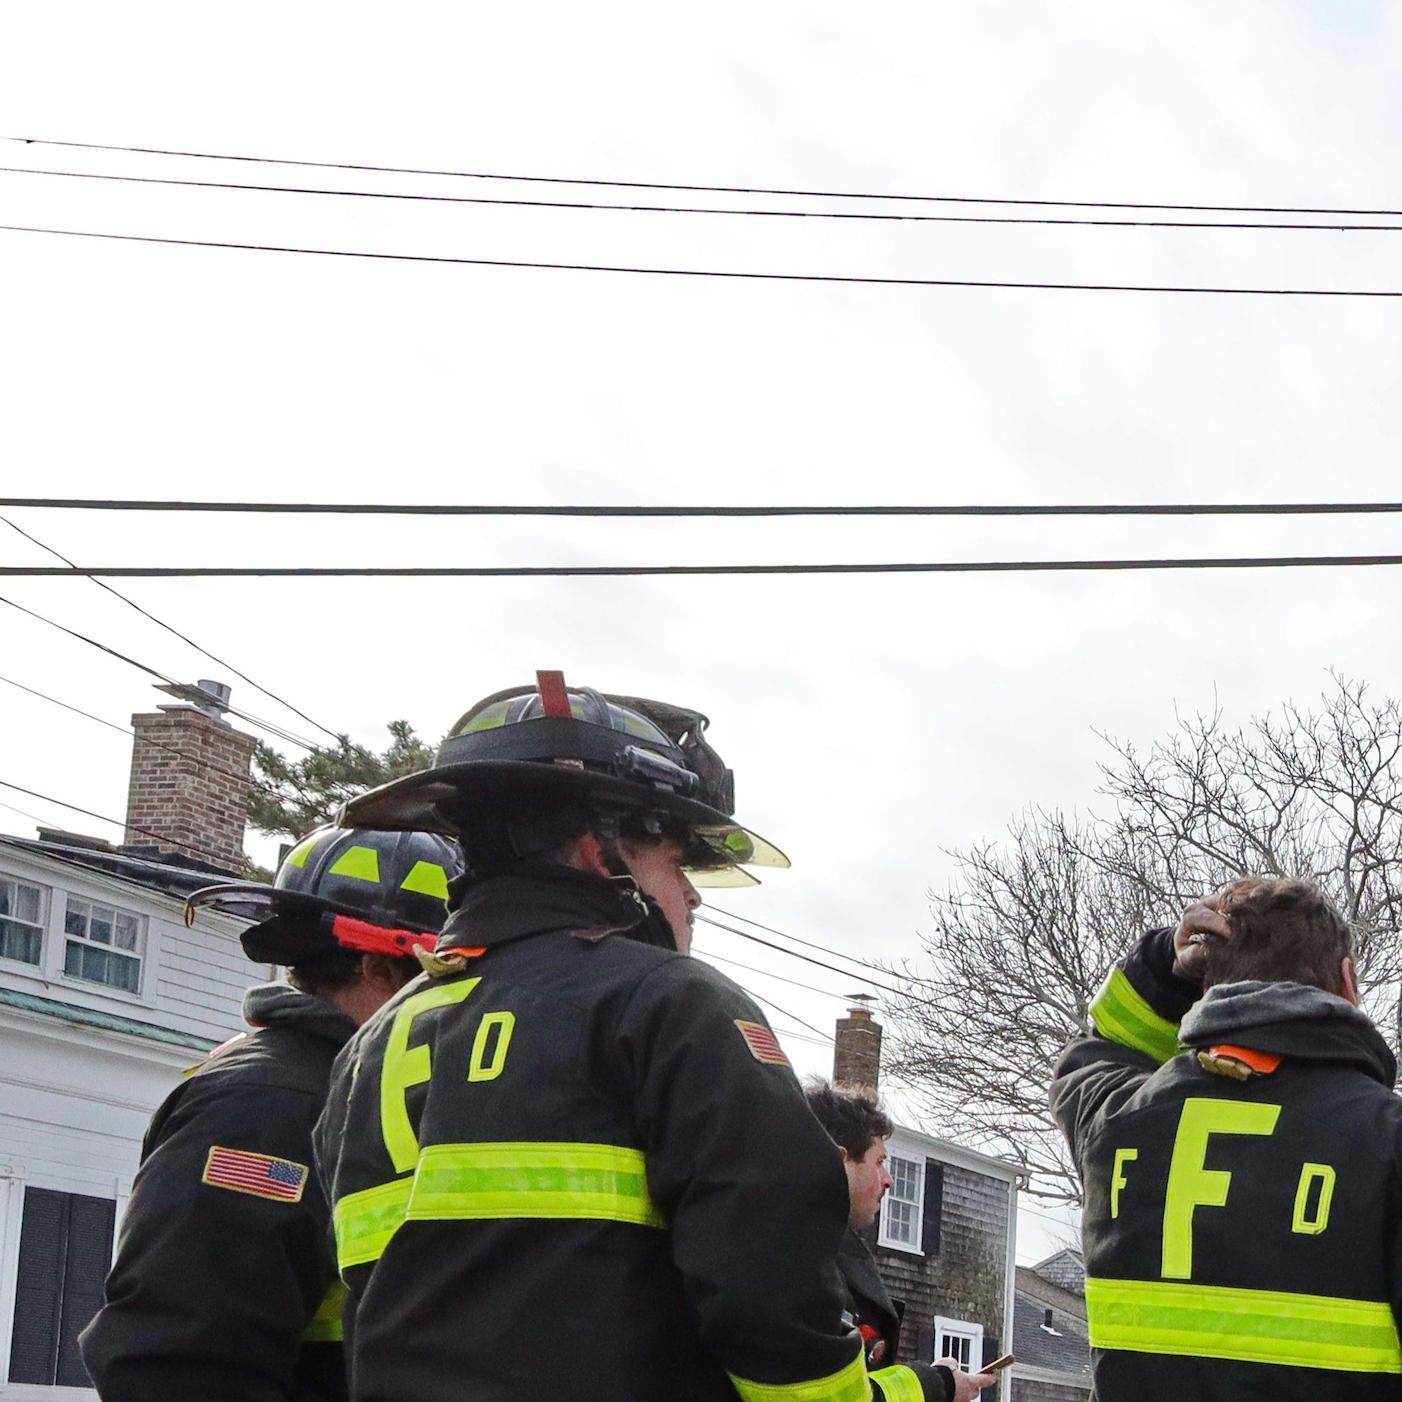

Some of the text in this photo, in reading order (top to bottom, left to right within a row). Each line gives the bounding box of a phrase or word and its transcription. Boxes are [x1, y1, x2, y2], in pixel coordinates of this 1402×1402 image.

[381, 976, 516, 1174] F D
[1110, 1097, 1336, 1280] F F D
